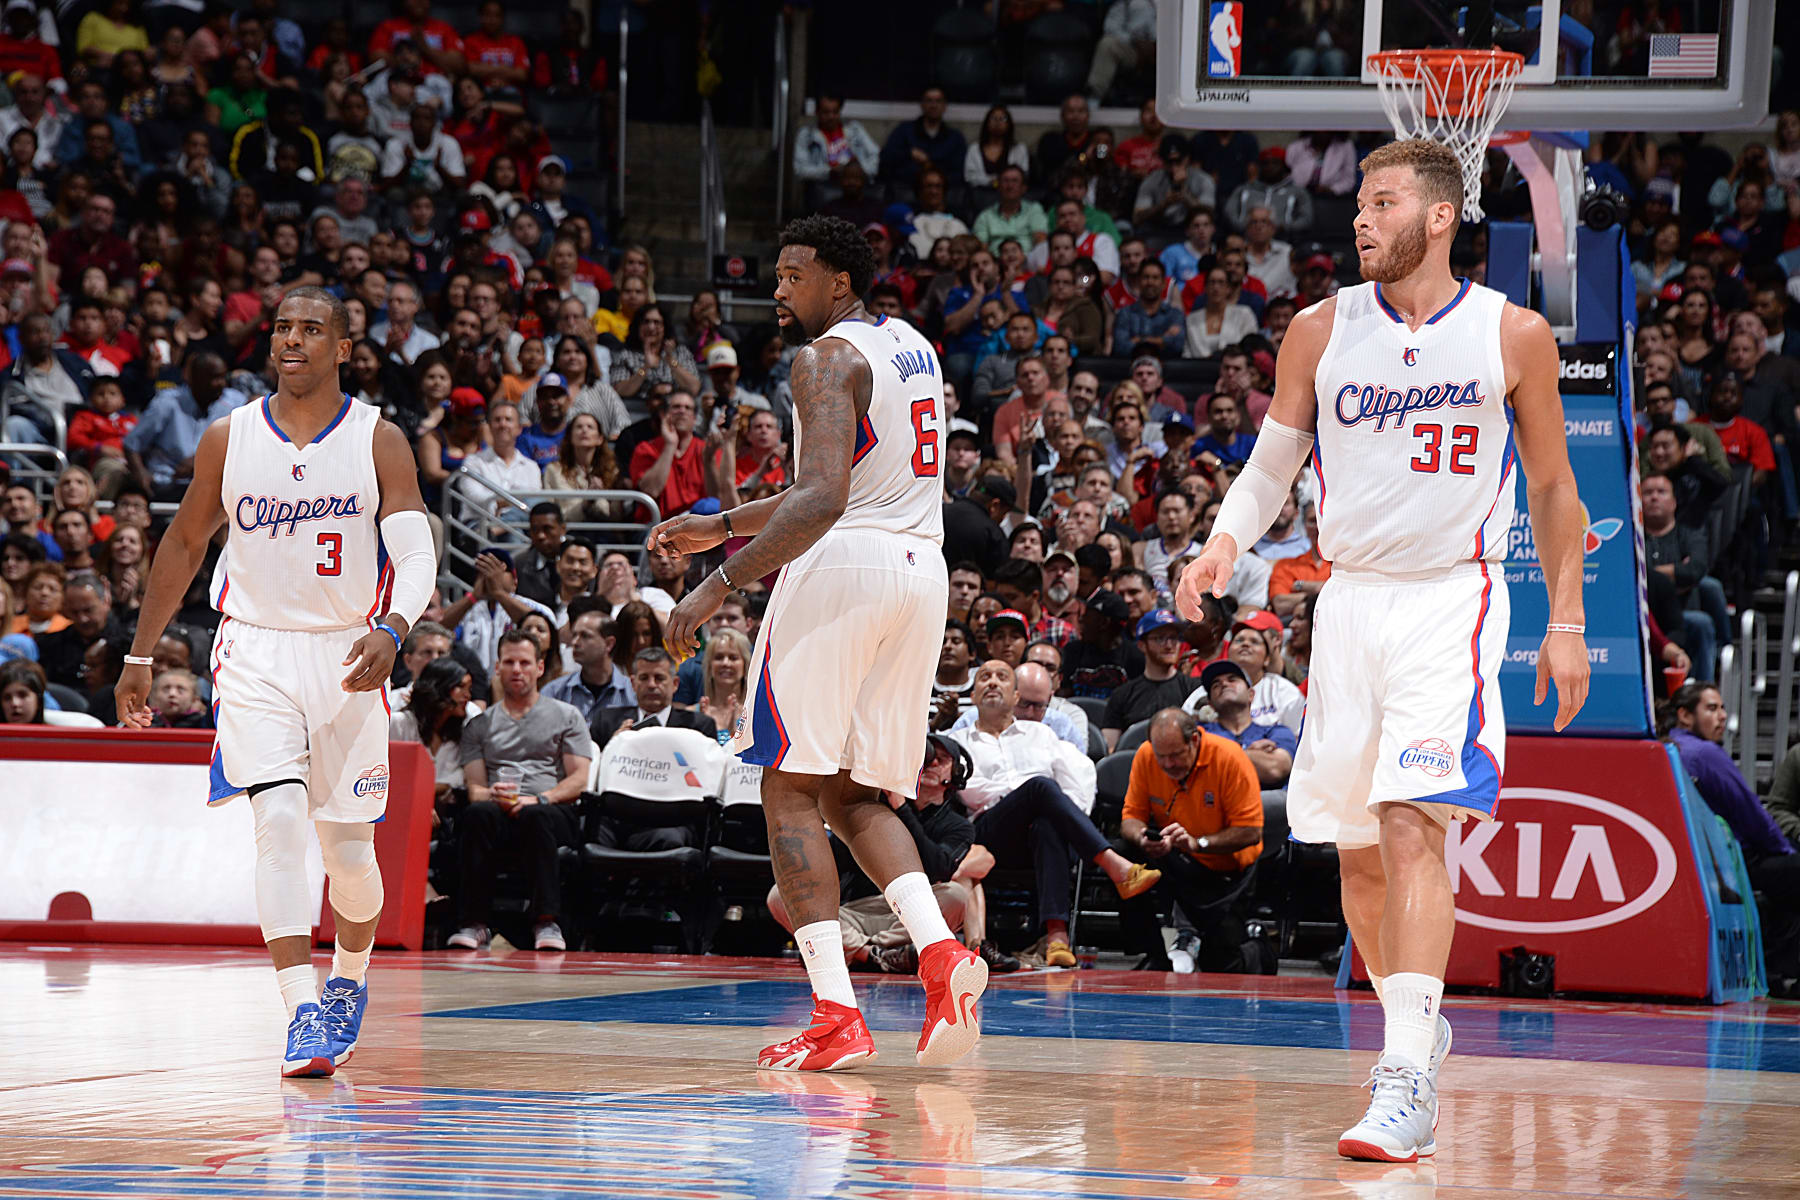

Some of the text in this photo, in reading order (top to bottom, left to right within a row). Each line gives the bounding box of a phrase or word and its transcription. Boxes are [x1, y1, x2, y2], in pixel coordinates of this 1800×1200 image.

[1210, 61, 1230, 75] NBA
[1196, 88, 1250, 103] SPALDING
[890, 349, 935, 383] JORDAN
[1559, 359, 1608, 380] idas
[1335, 378, 1486, 433] Clippers
[910, 397, 939, 479] 6
[1564, 420, 1614, 436] ONATE
[1410, 423, 1480, 476] 32
[236, 492, 365, 540] Clippers
[316, 532, 343, 577] 3
[1503, 647, 1609, 666] A.org ATE
[611, 754, 671, 771] American
[1399, 747, 1450, 770] CLIPPERS
[618, 764, 669, 783] Airlines
[729, 764, 761, 777] Amer
[1444, 820, 1626, 903] KIA
